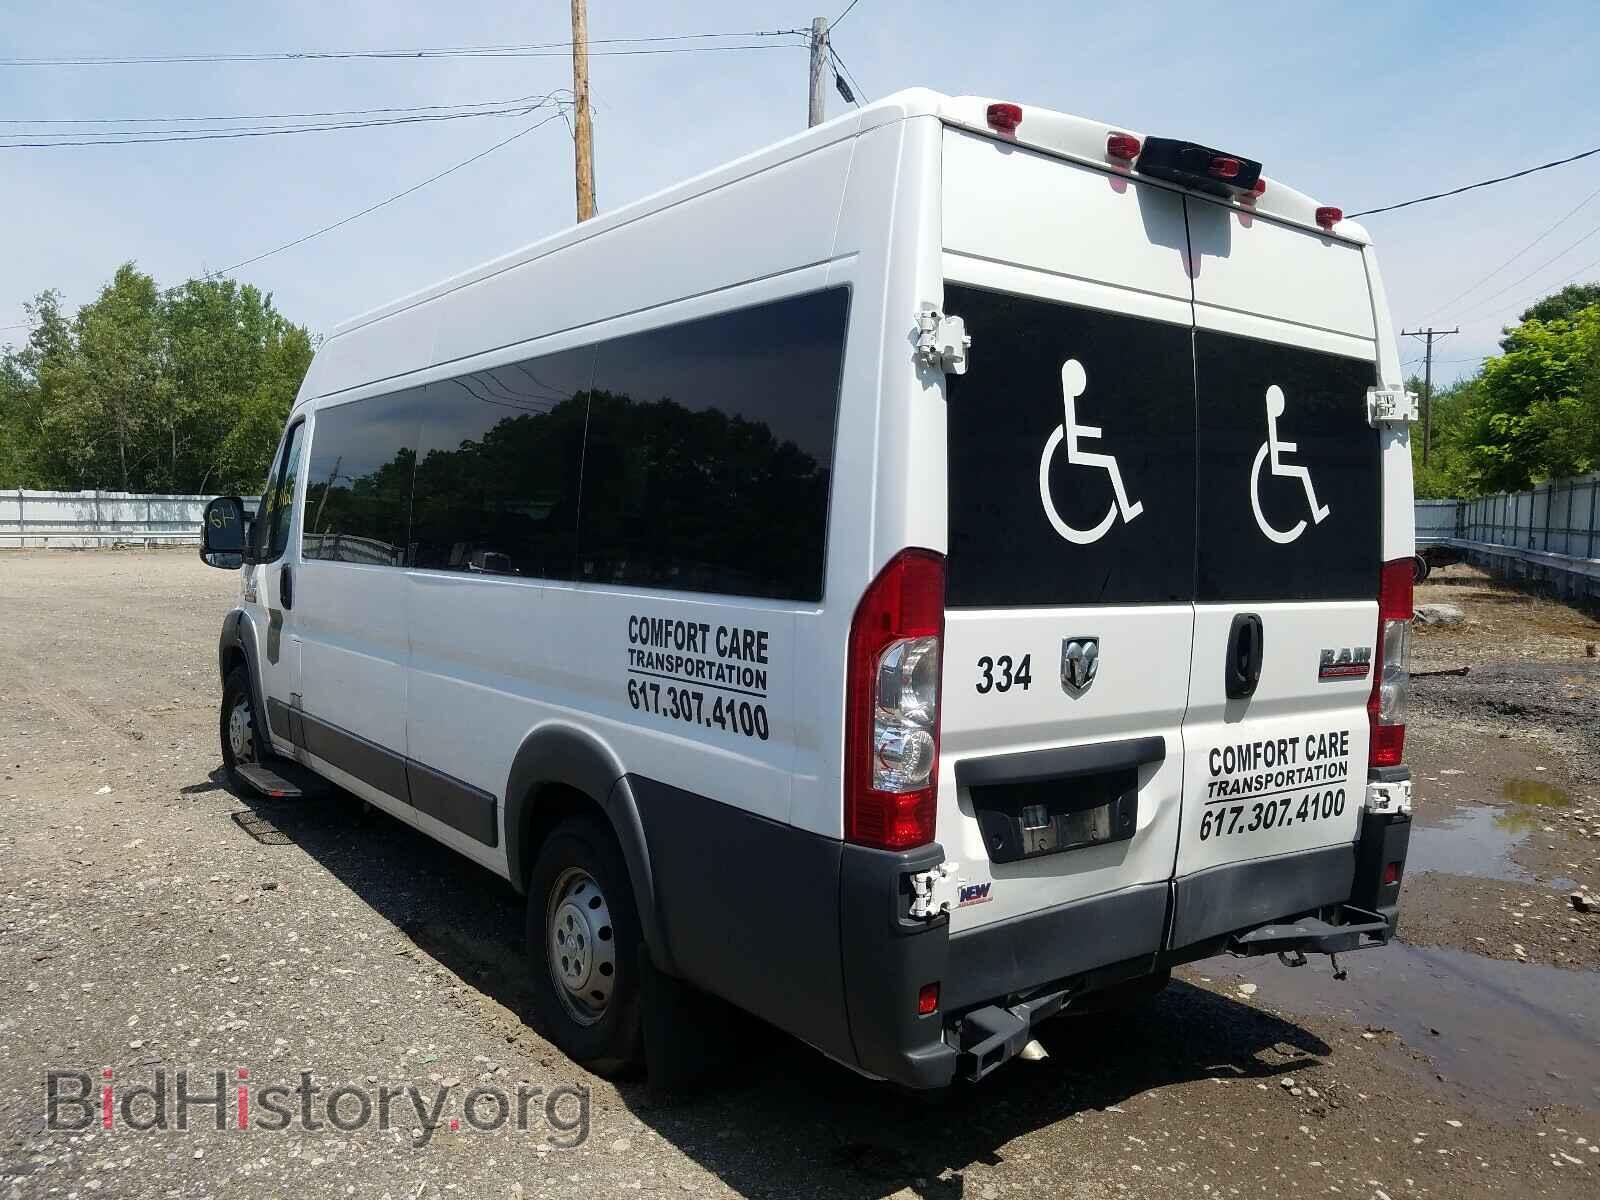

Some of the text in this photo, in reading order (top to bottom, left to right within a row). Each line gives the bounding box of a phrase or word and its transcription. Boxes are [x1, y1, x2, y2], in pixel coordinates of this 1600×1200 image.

[628, 615, 769, 665] COMFORT CARE
[1319, 646, 1372, 666] RAM
[627, 647, 767, 691] TRANSPORTATION
[975, 653, 1032, 694] 334
[627, 678, 769, 741] 617.307.4100
[1208, 729, 1350, 777] COMFORT CARE
[1207, 760, 1348, 799] TRANSPORTATION
[1199, 787, 1346, 842] 617.307.4100
[959, 882, 991, 903] NEW
